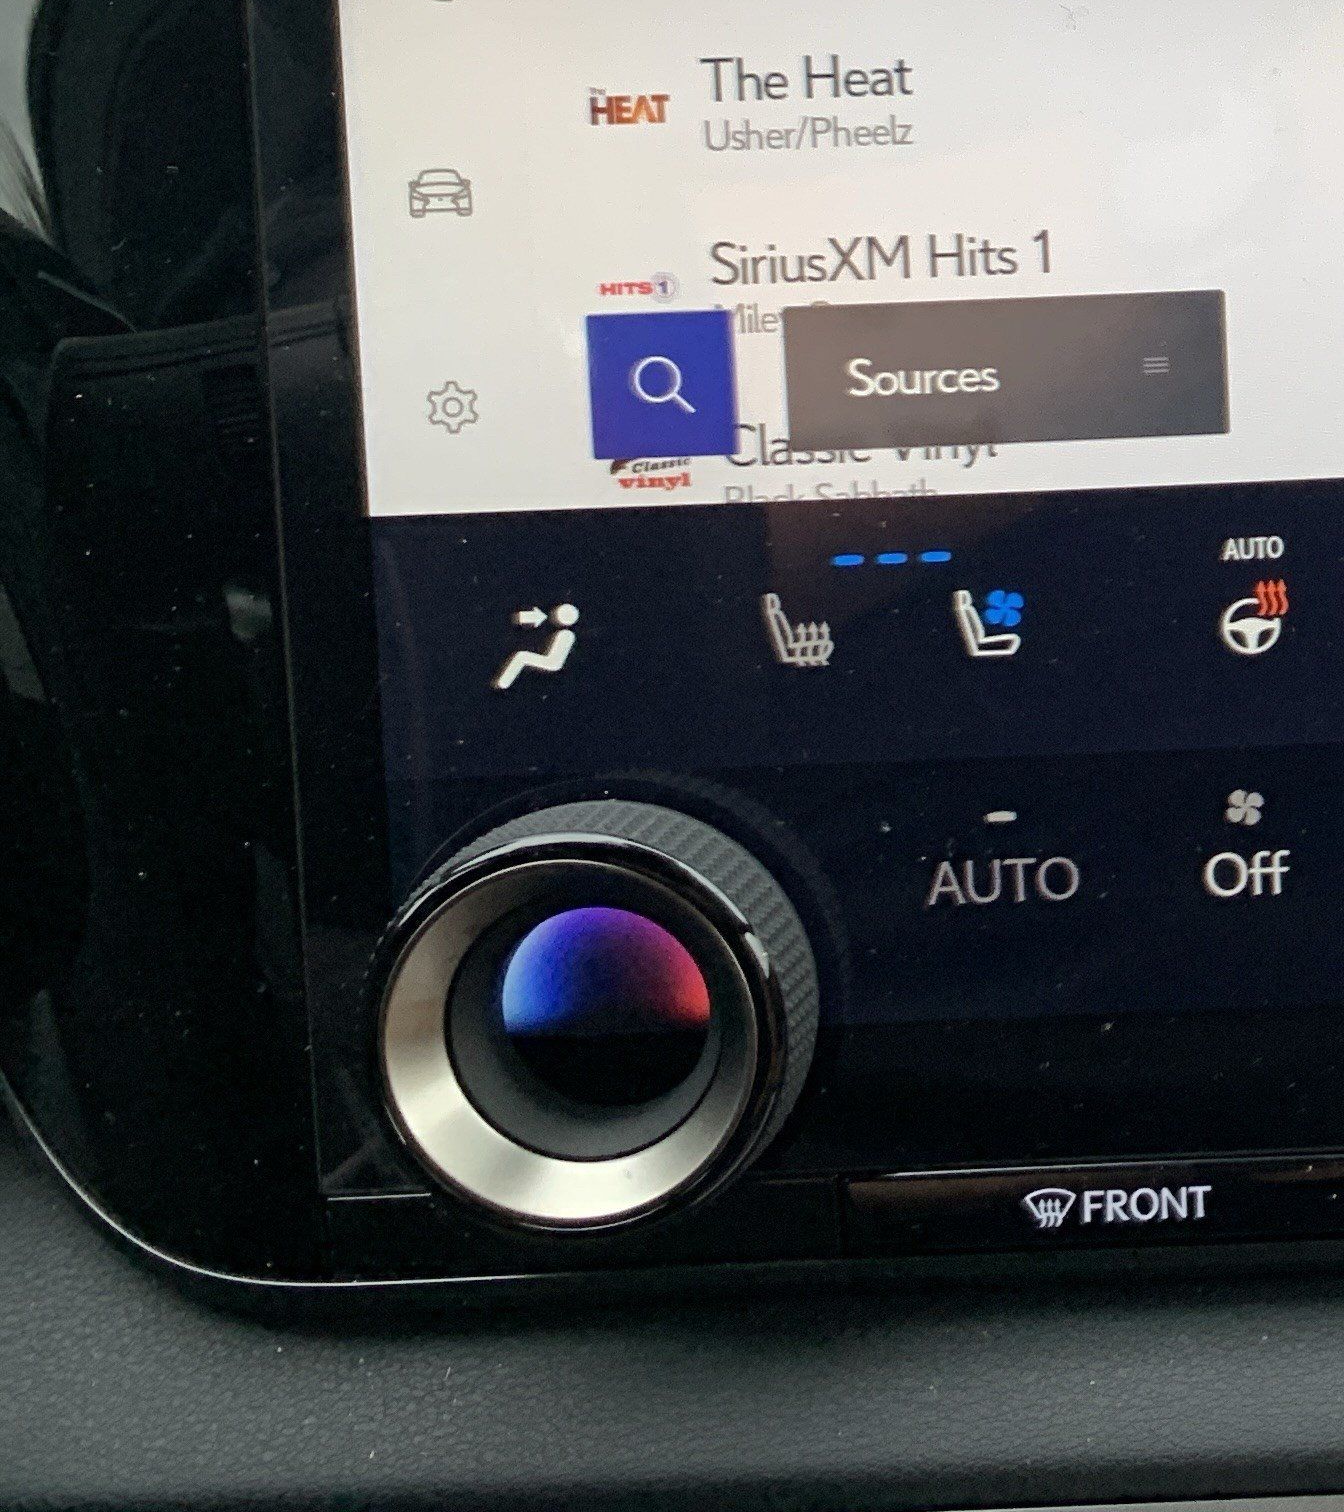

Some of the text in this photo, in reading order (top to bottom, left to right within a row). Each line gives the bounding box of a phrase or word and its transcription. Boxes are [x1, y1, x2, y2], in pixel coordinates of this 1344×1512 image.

[700, 54, 914, 101] The Heat
[589, 94, 671, 125] HEAT
[704, 115, 914, 151] Usher/Pheelz
[711, 229, 1052, 288] SiriusXM Hits 1
[599, 281, 654, 296] HITS
[847, 357, 1000, 398] Sources
[618, 471, 692, 491] vinyl
[1221, 535, 1285, 562] AUTO
[926, 856, 1081, 909] AUTO
[1204, 849, 1291, 899] Off
[1081, 1184, 1213, 1226] FRONT
